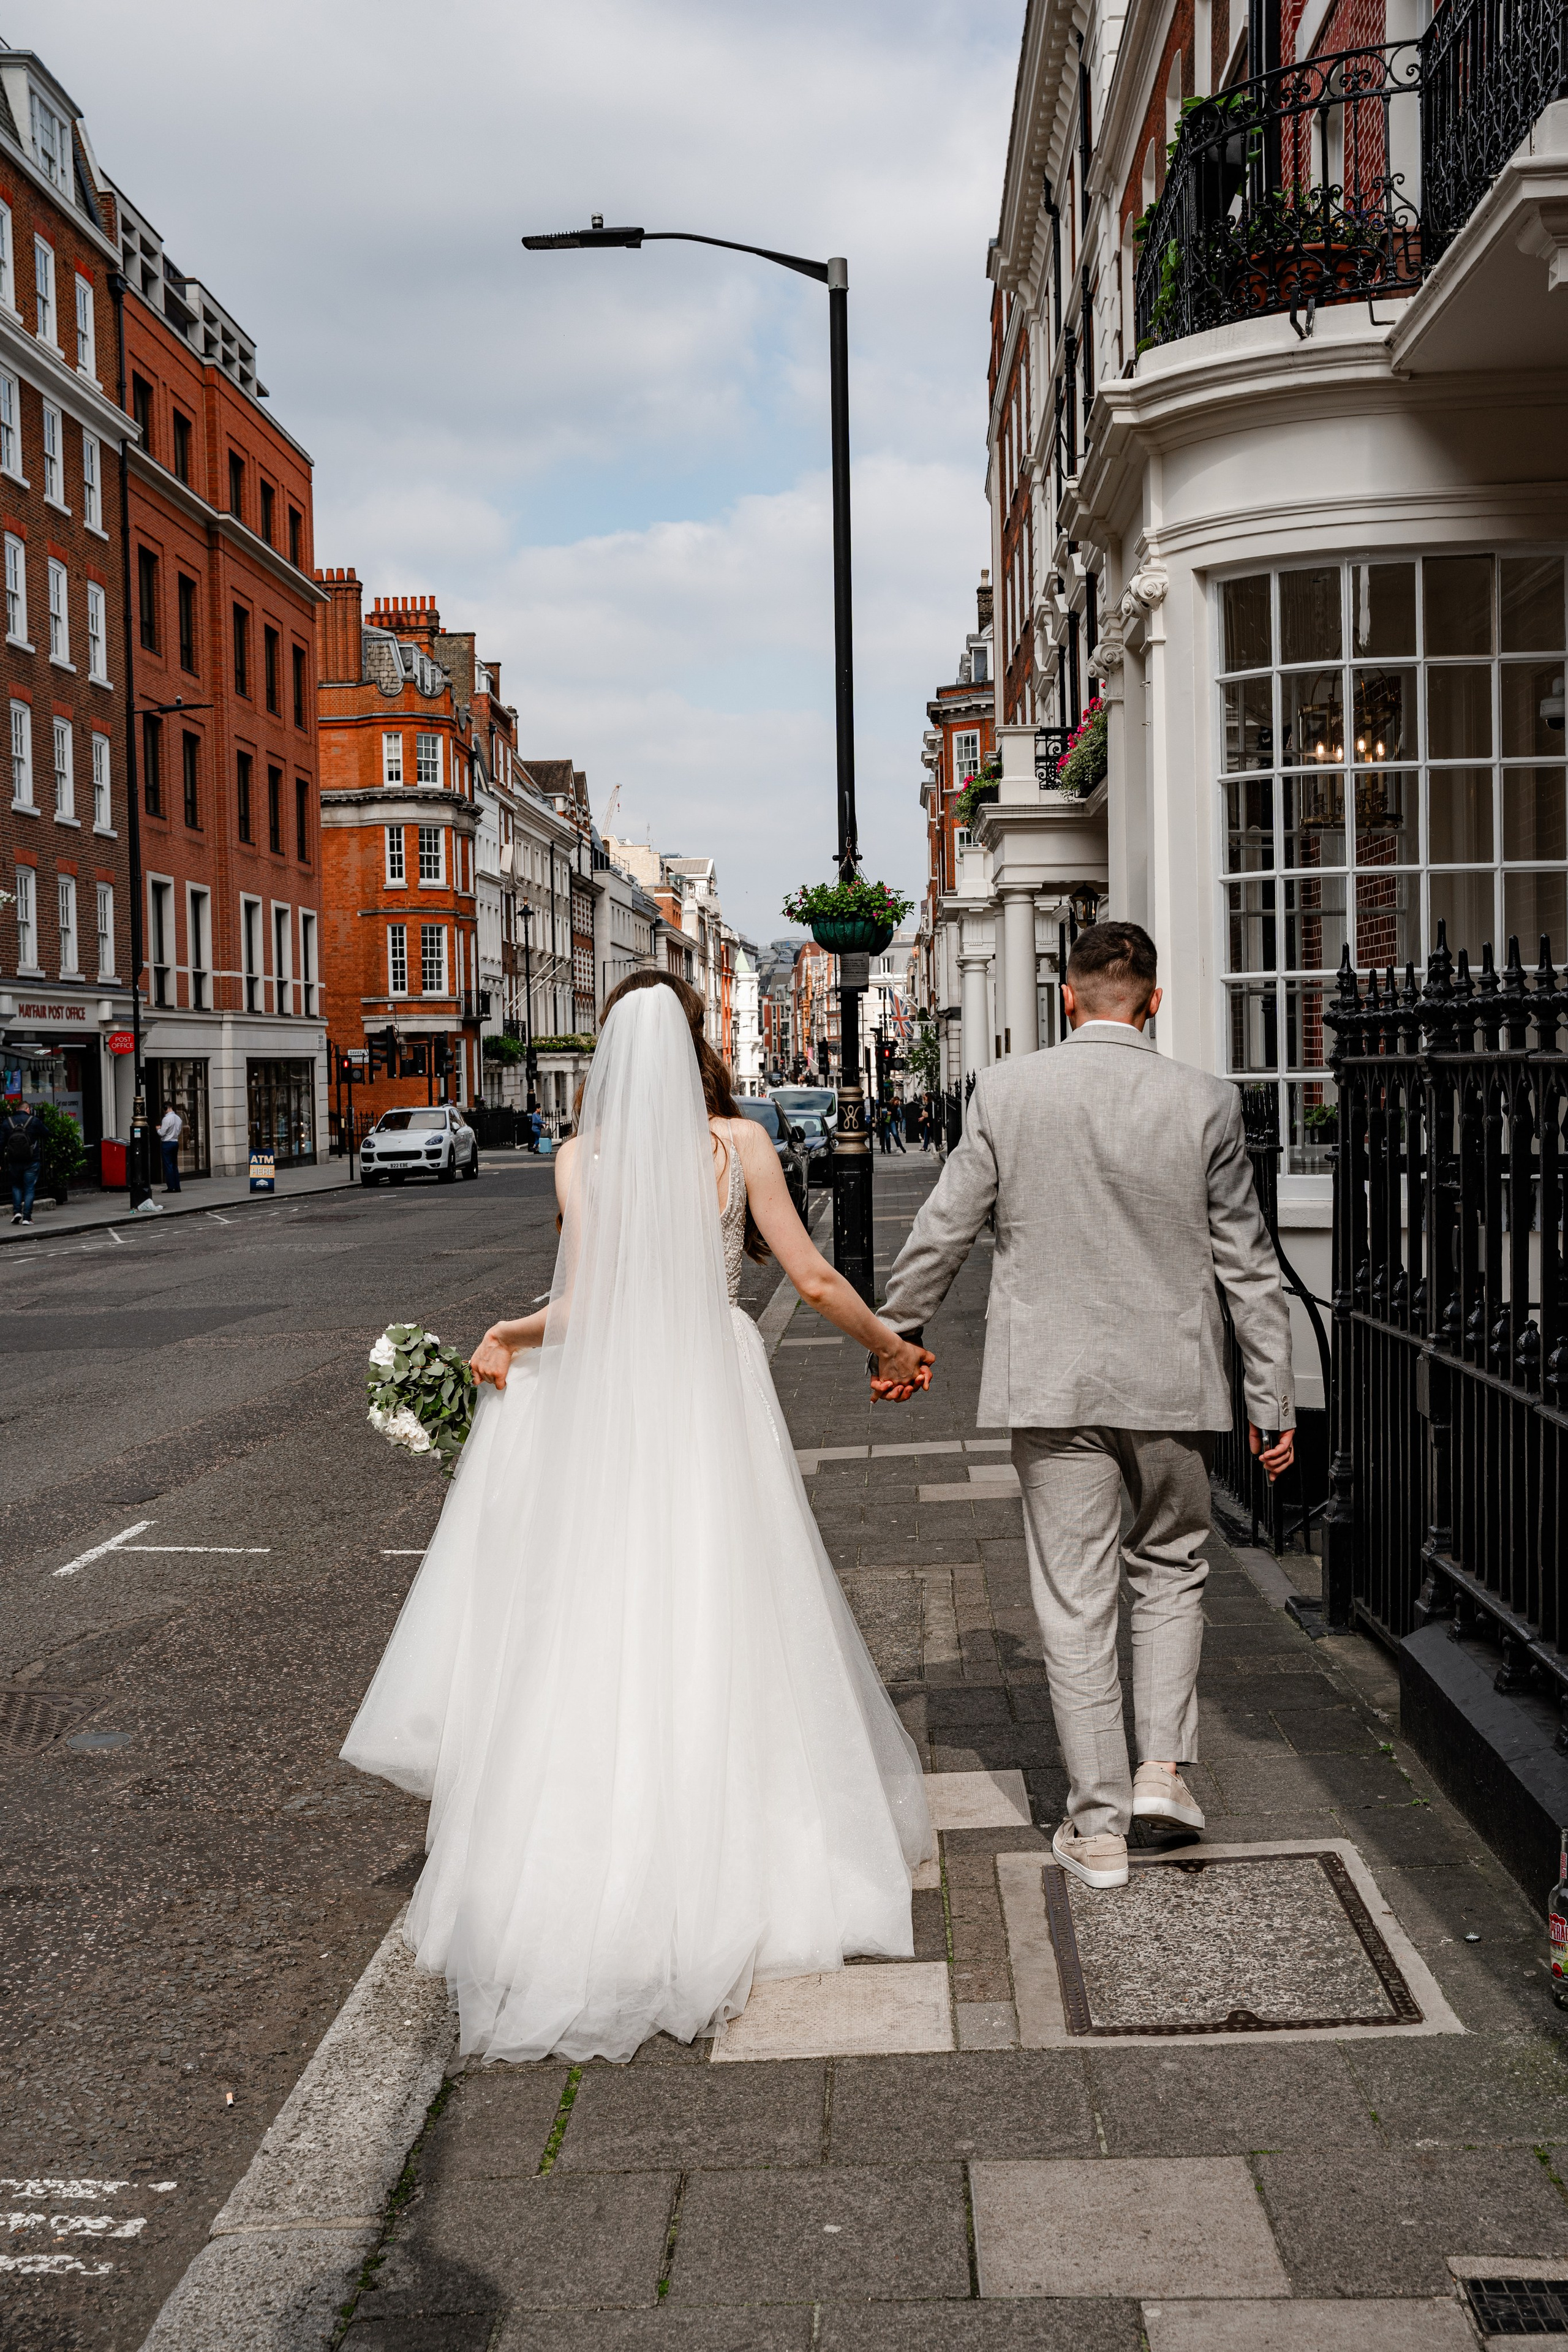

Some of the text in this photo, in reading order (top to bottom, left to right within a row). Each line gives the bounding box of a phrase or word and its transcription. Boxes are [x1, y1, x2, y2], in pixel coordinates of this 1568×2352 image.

[18, 1004, 85, 1020] MAYFAIR POST OFFICE
[251, 1155, 274, 1164] ATM
